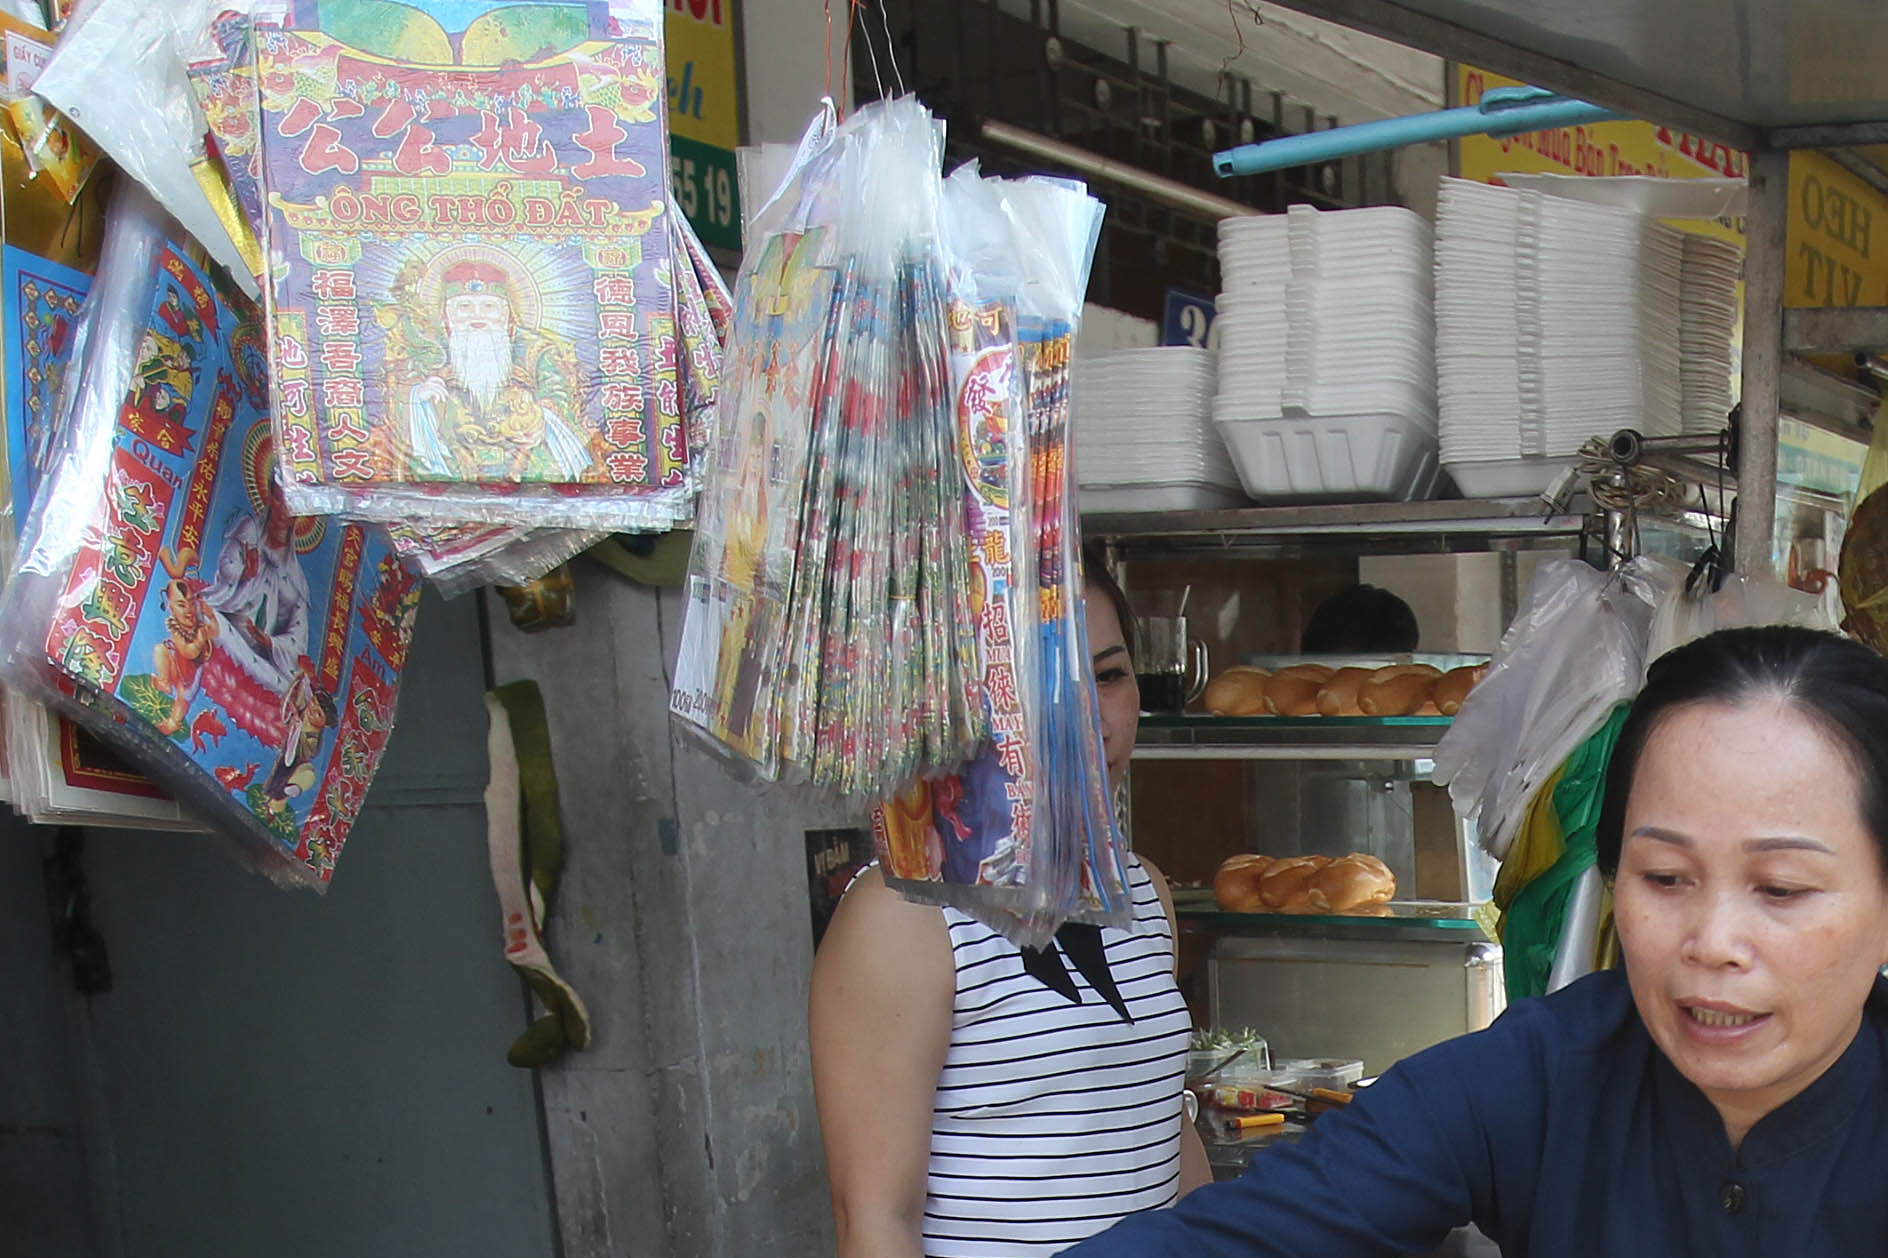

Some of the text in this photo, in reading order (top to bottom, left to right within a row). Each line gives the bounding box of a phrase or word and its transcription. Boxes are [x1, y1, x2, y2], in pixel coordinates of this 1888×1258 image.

[330, 181, 614, 227] ÔNG THỔ ĐẤT
[704, 164, 731, 228] 19
[132, 438, 184, 490] Quan
[998, 734, 1025, 776] 有
